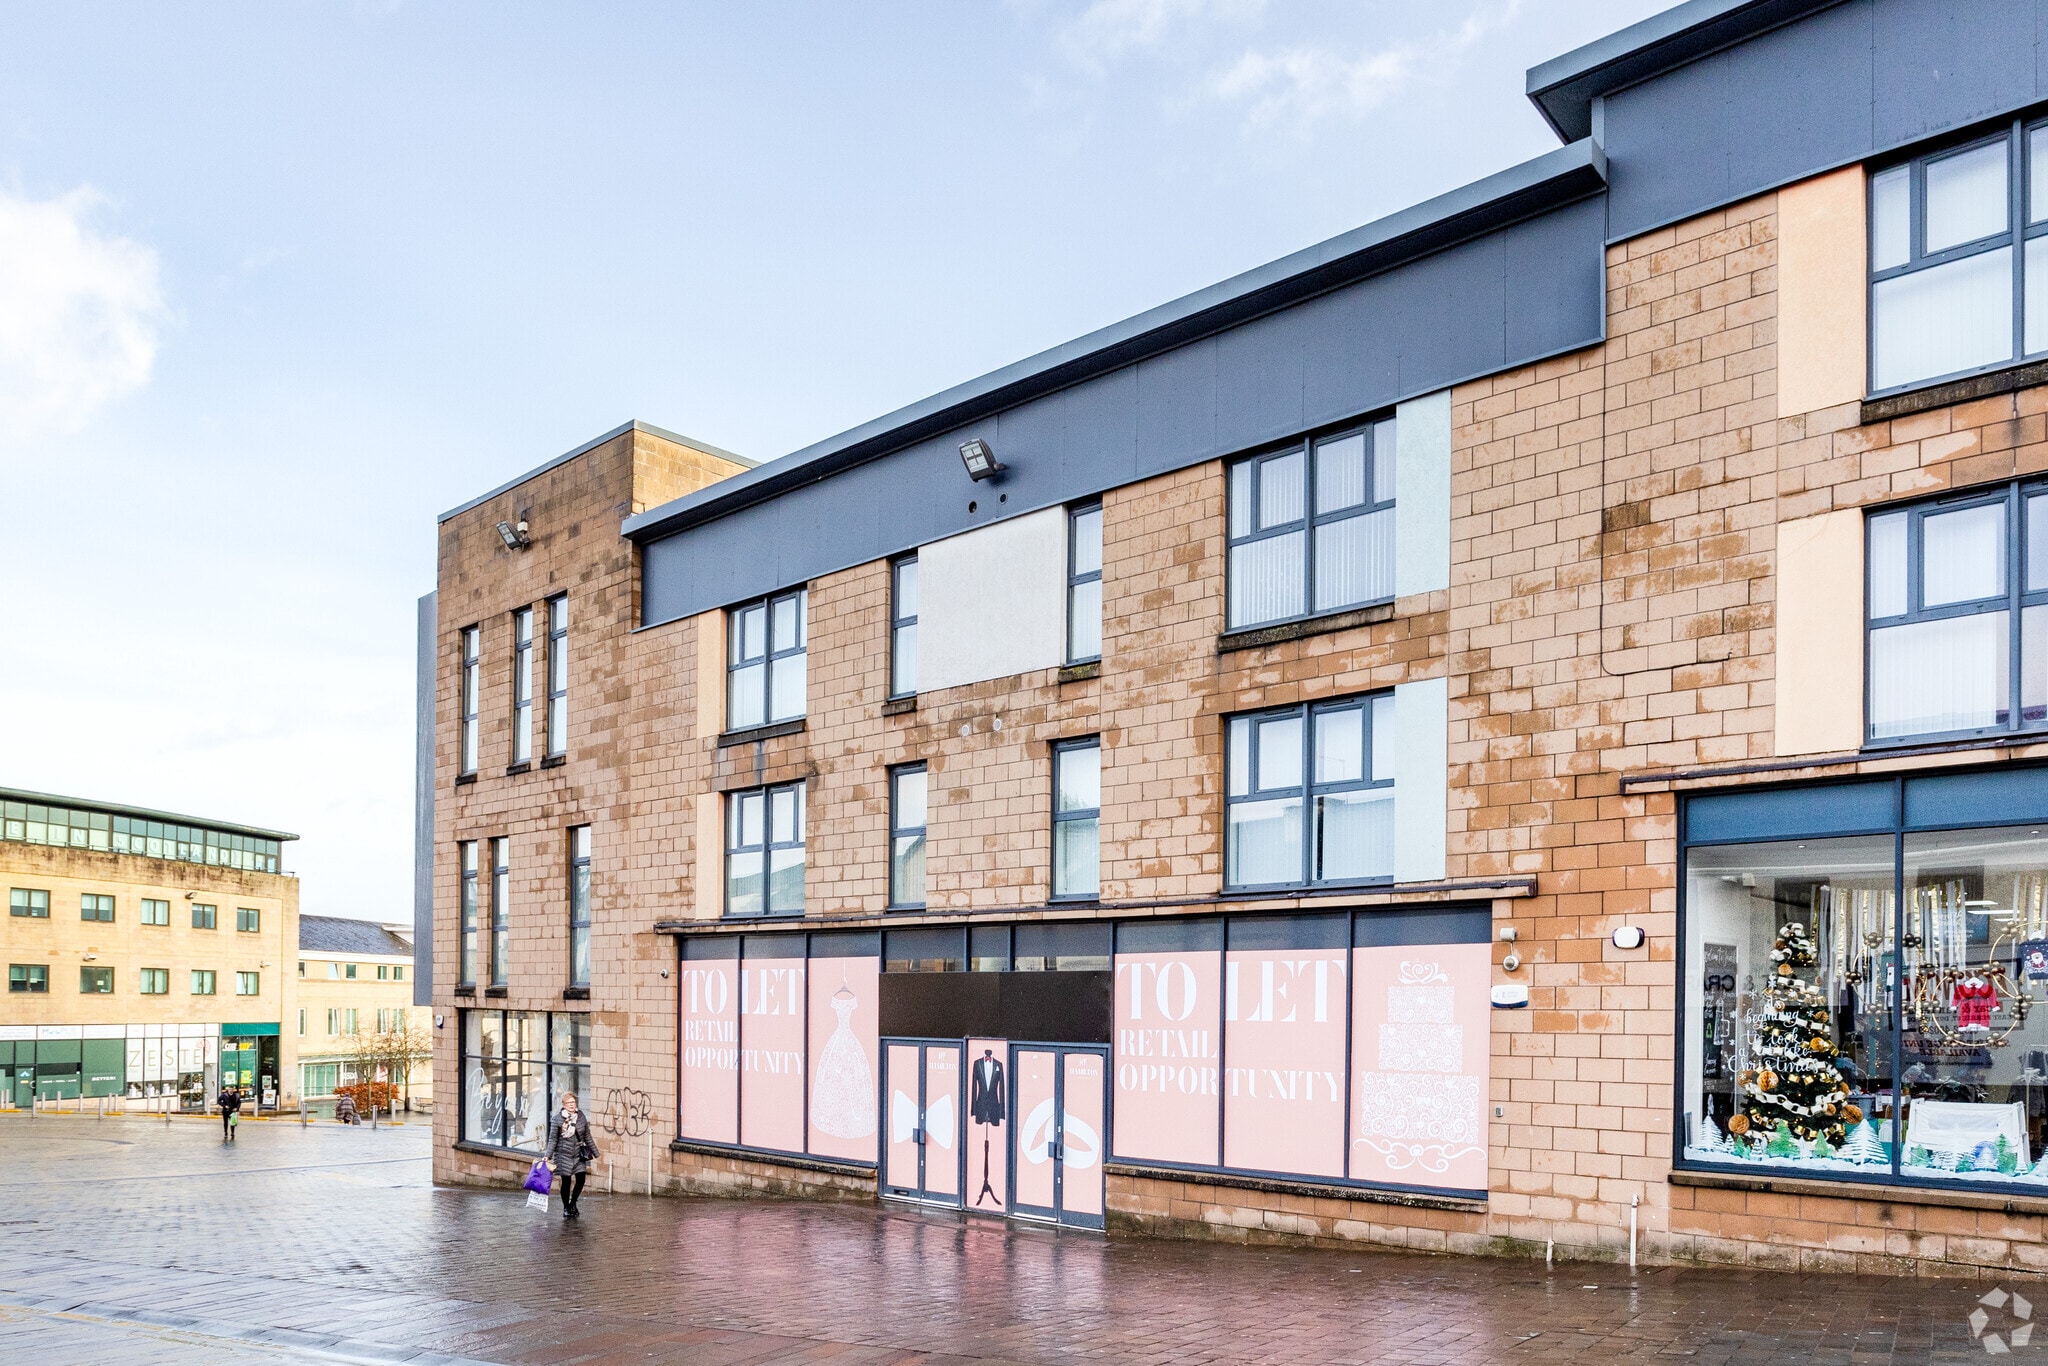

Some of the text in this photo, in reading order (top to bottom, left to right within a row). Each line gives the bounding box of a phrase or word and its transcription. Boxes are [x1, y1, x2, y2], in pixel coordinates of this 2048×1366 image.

[684, 967, 805, 1016] TO LET
[1117, 959, 1346, 1023] TO LET
[685, 1020, 738, 1043] RETAIL
[1120, 1028, 1218, 1058] RETAIL
[128, 1048, 201, 1068] ZESTE
[685, 1047, 805, 1075] OPPORTUNITY
[1727, 1055, 1818, 1074] Christmas
[1119, 1062, 1345, 1102] OPPORTUNITY
